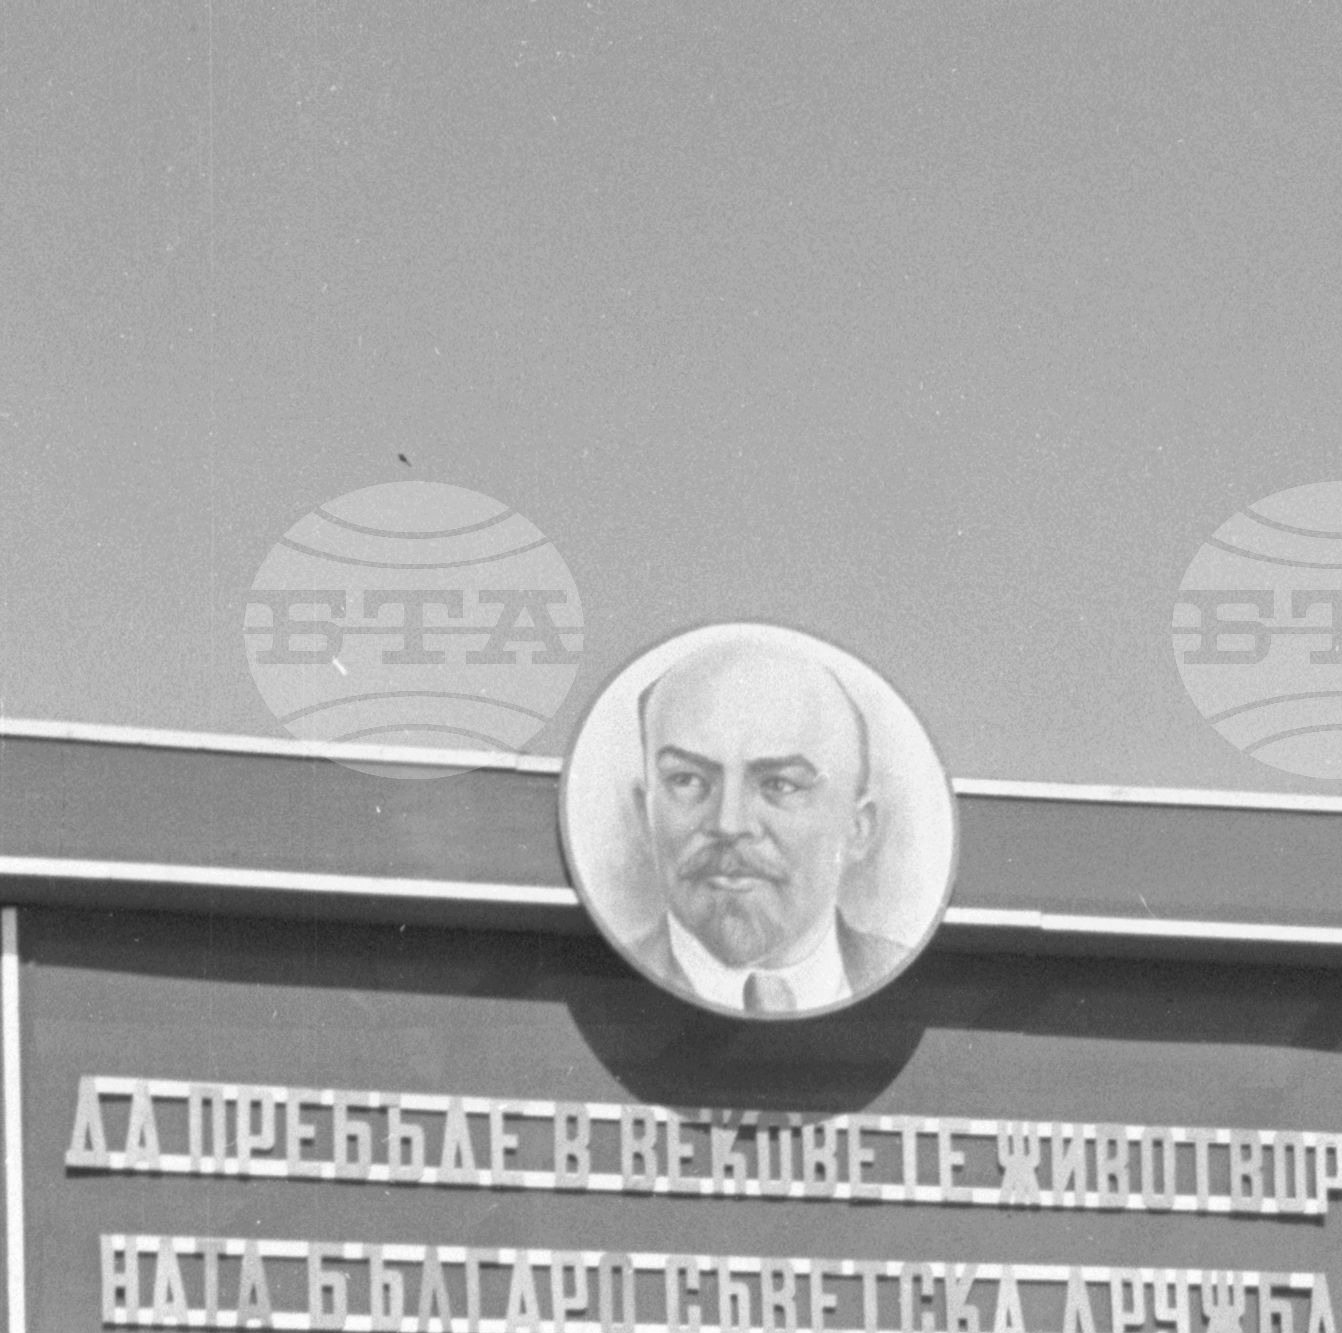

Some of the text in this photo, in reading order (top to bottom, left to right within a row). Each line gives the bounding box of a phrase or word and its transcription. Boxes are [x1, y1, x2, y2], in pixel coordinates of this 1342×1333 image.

[65, 1076, 160, 1172] ДА
[187, 1081, 525, 1187] ПРЕБЪДЕ
[553, 1101, 591, 1190] В
[620, 1103, 973, 1203] ВЕКОВЕТЕ
[100, 1234, 273, 1327] НАТА
